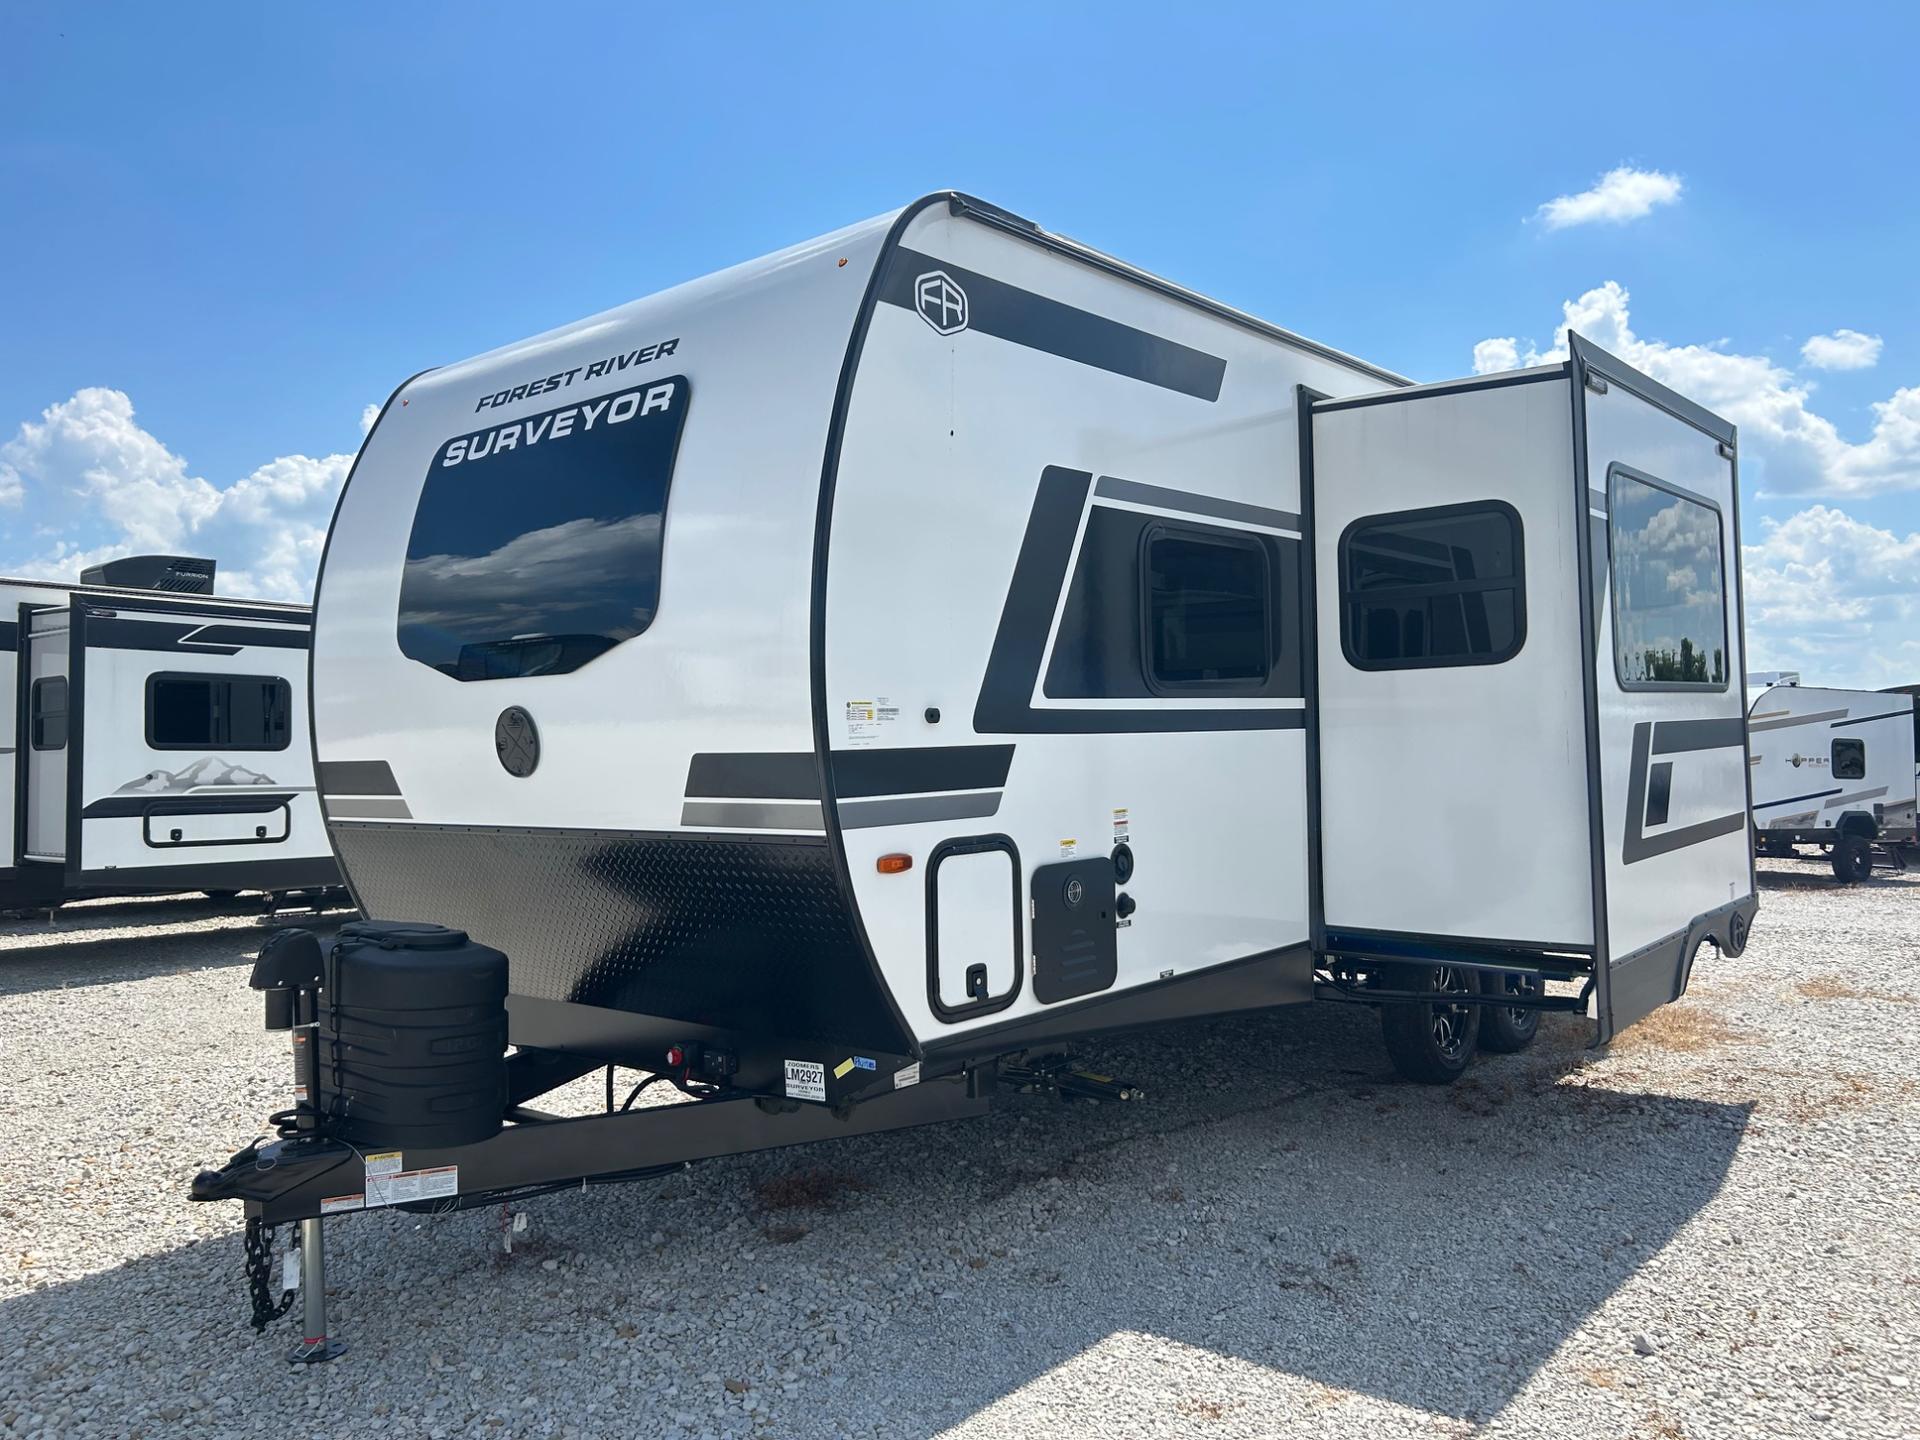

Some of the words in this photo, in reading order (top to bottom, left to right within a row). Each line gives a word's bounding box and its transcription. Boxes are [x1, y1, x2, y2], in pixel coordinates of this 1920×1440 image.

[475, 366, 582, 413] FOREST
[584, 337, 680, 381] RIVER
[442, 382, 676, 467] SURVEYOR
[175, 571, 209, 579] FURRION
[787, 1061, 820, 1070] ZOOMERS
[785, 1067, 823, 1084] LM2927
[785, 1083, 824, 1092] SURVEYOR
